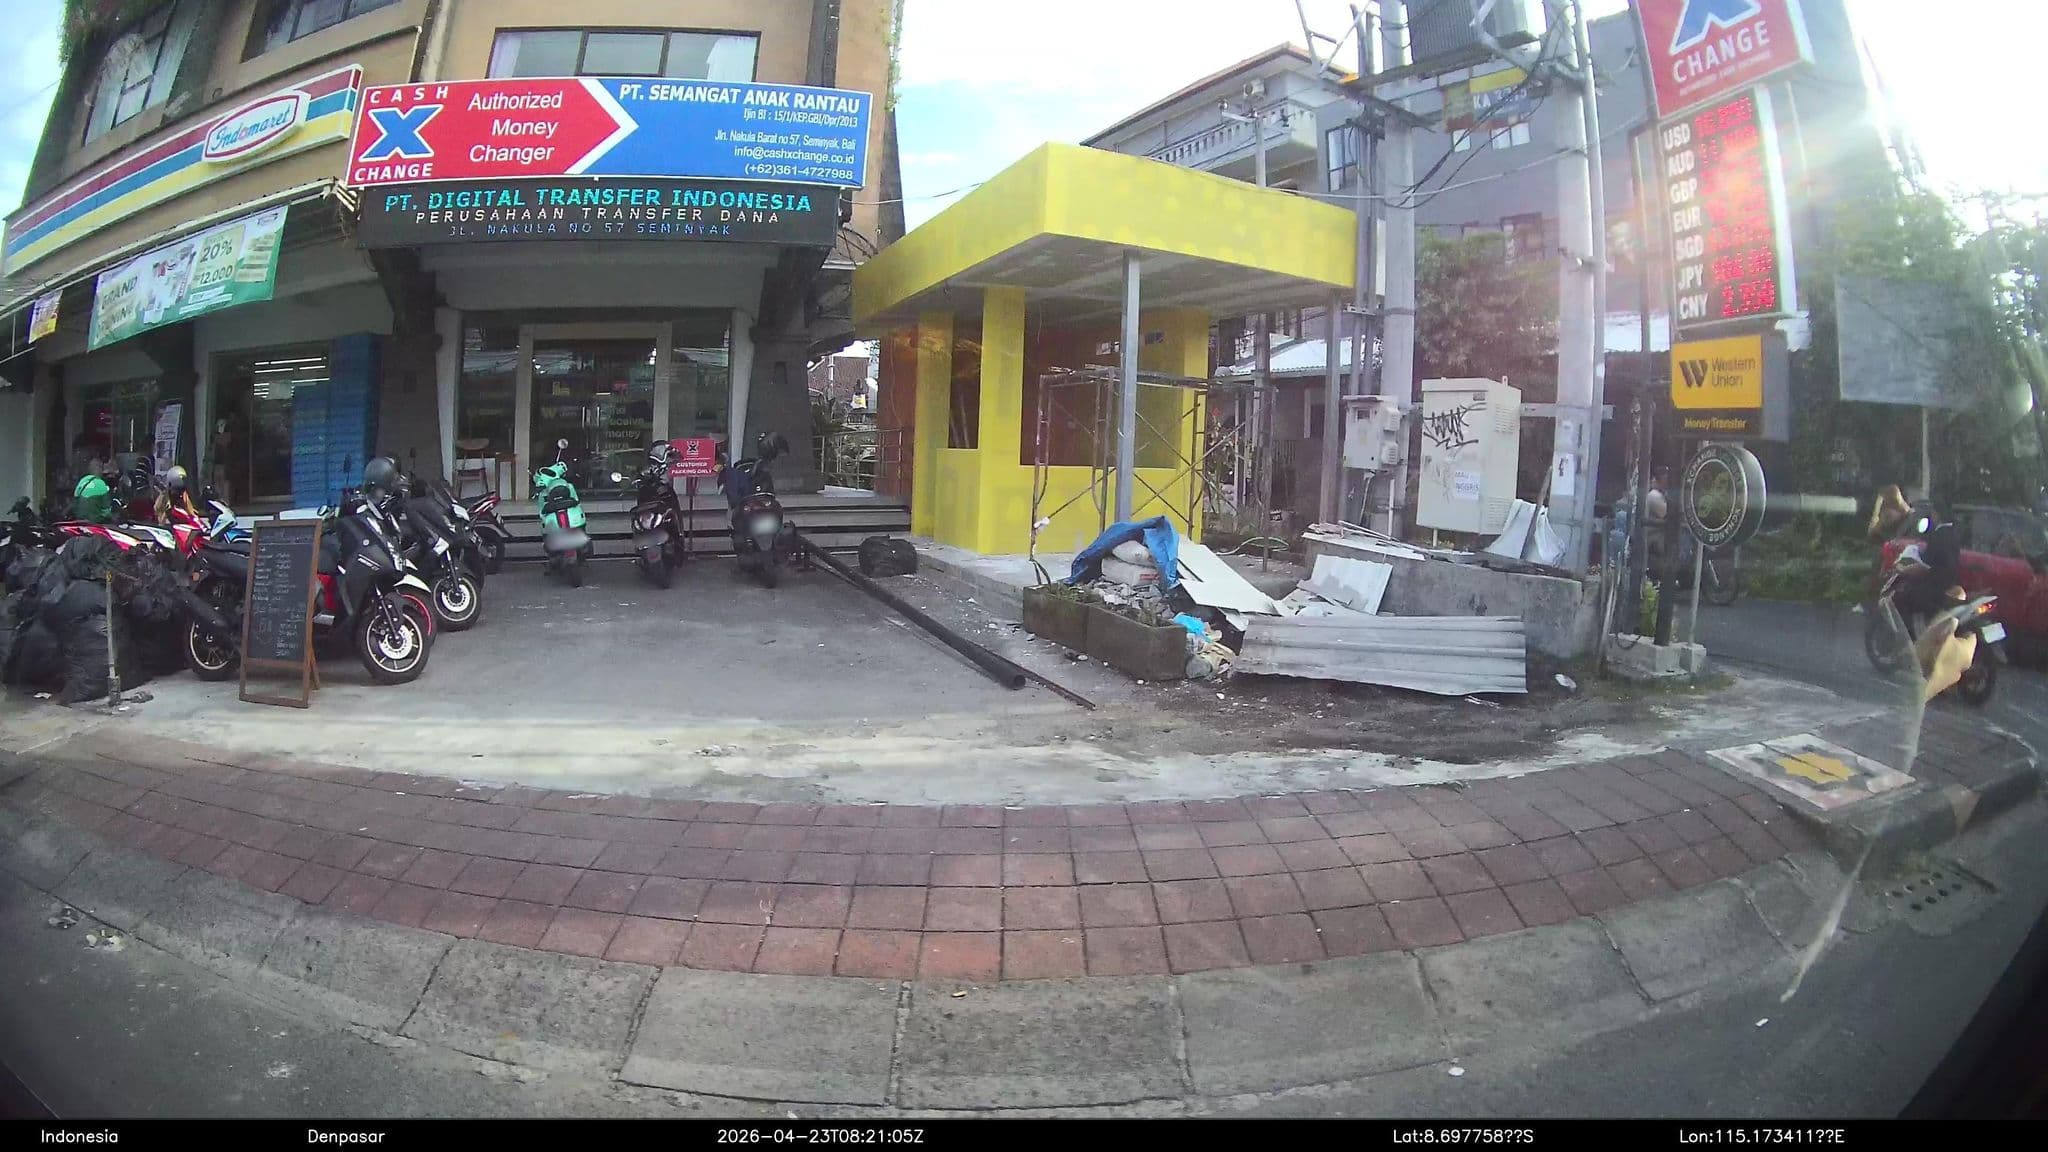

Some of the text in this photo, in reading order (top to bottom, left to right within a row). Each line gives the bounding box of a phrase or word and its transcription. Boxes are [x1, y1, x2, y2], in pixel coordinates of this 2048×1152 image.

[1673, 20, 1770, 83] CHANGE
[370, 86, 448, 103] CASH
[467, 90, 563, 111] Authorized
[620, 84, 860, 113] PT. SEMANGAT ANAK RANTAU
[211, 104, 291, 151] Indomaret
[492, 119, 560, 139] Money
[1664, 123, 1690, 150] USD
[730, 130, 756, 142] Nakula
[757, 132, 777, 143] Barat
[841, 139, 856, 151] Bali
[469, 145, 555, 165] Changer
[734, 146, 854, 164] info@cashxchange.co.id
[1668, 150, 1695, 177] AUD
[354, 163, 433, 181] CHANGE
[744, 164, 853, 179] (+62)361-4727988
[385, 189, 811, 212] PT. DIGITAL TRANSFER INDONESIA
[1670, 178, 1697, 204] GBP
[416, 208, 779, 223] PERUSAHAAN TRANSFER DANA
[1673, 206, 1702, 233] EUR
[487, 223, 556, 235] NAKULA
[569, 222, 592, 233] NO
[605, 222, 625, 233] 57
[200, 238, 233, 264] 20%
[200, 265, 233, 285] 12.000
[1678, 264, 1704, 290] JPY
[1680, 293, 1708, 320] CNY
[1712, 356, 1756, 372] Western
[1712, 373, 1743, 387] Union
